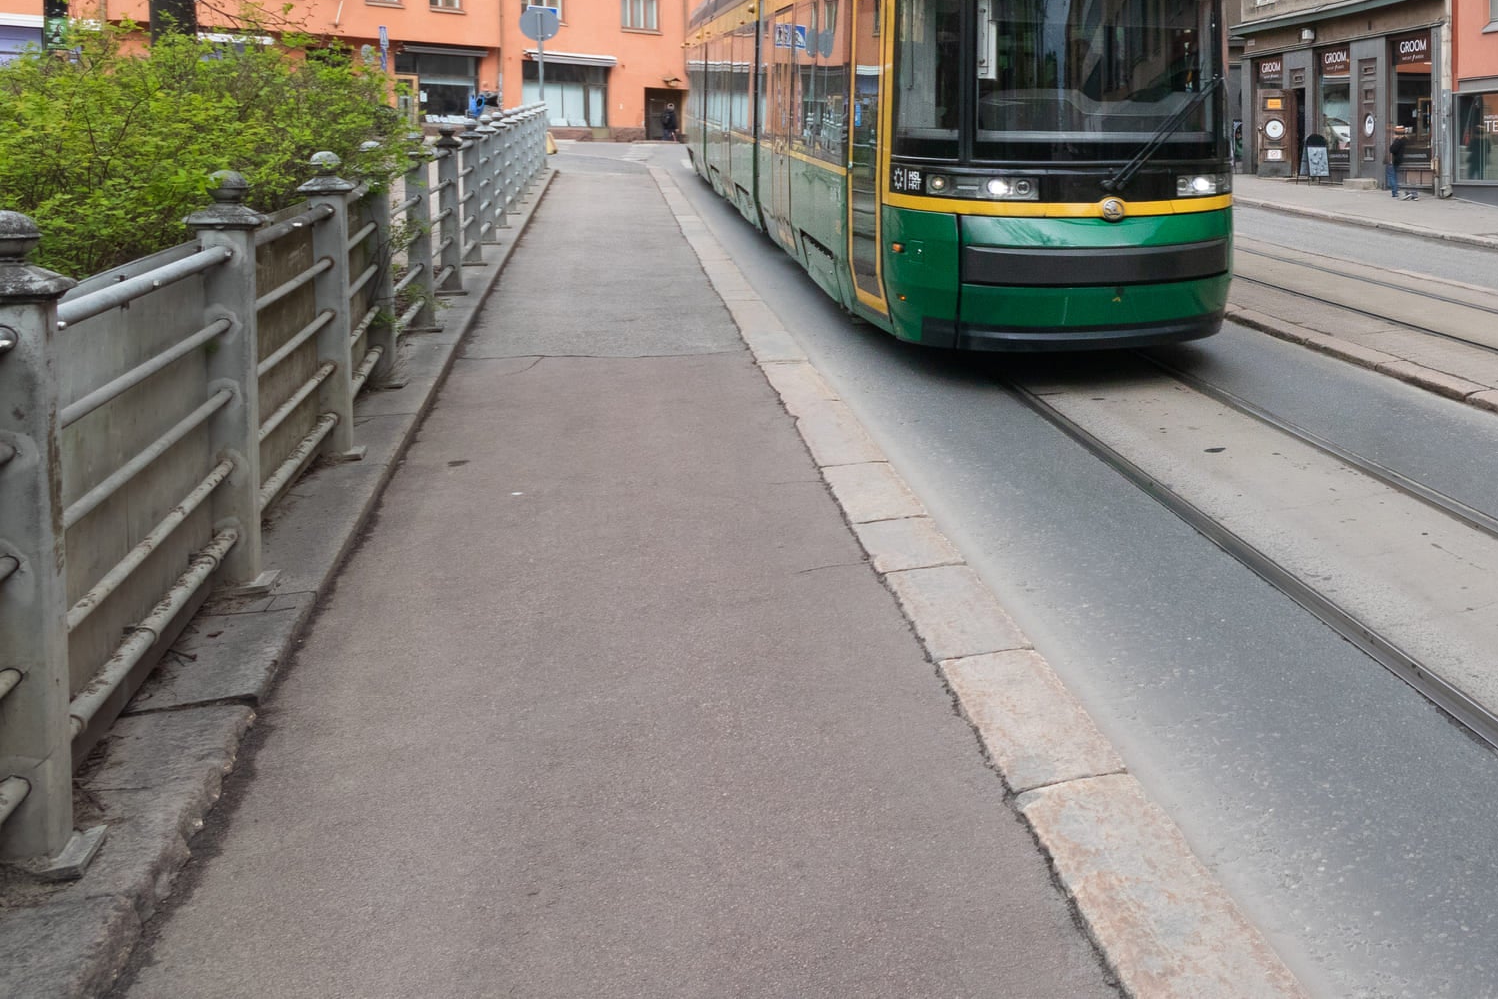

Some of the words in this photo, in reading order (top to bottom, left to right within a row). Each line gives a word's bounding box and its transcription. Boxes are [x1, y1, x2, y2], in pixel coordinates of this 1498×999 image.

[1400, 39, 1427, 53] GROOM
[1325, 51, 1347, 64] GROOM
[1261, 61, 1281, 74] GROOM
[908, 171, 921, 181] HSL
